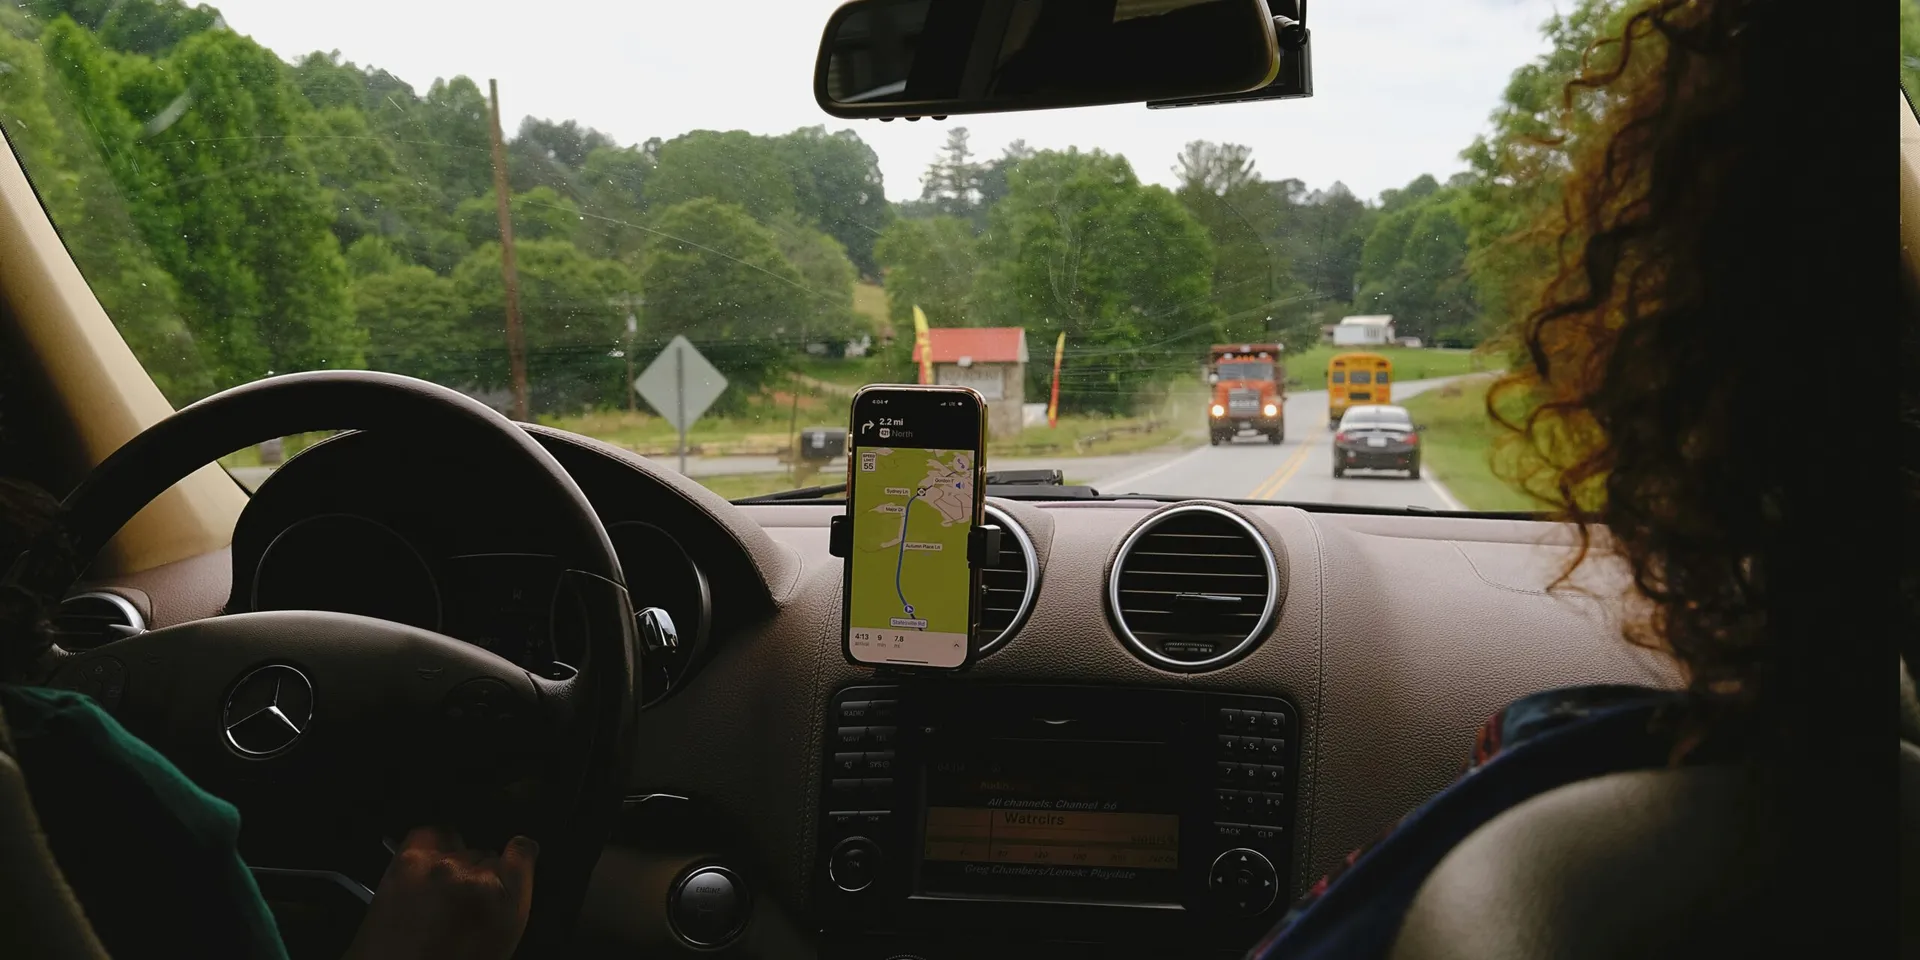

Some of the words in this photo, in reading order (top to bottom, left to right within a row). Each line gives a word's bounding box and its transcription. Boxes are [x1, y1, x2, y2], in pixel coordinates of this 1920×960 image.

[879, 418, 892, 426] 2.2
[893, 418, 904, 426] mi
[891, 430, 914, 438] North
[894, 635, 904, 643] 7.8
[843, 709, 864, 717] RADIO
[1249, 716, 1256, 724] 2
[1272, 718, 1278, 726] 3
[842, 735, 860, 743] NAVI
[1225, 767, 1232, 775] 7
[1248, 769, 1254, 777] 8
[1271, 770, 1277, 778] 9
[1247, 796, 1253, 804] 0
[987, 798, 1002, 807] All
[1003, 799, 1053, 809] channels:
[1055, 799, 1099, 810] Channel
[1103, 800, 1118, 811] 66
[1220, 827, 1241, 836] BACK
[1257, 830, 1274, 839] CLR
[965, 863, 990, 876] Greg
[1090, 868, 1136, 881] Playdate
[695, 886, 722, 894] ENGINE
